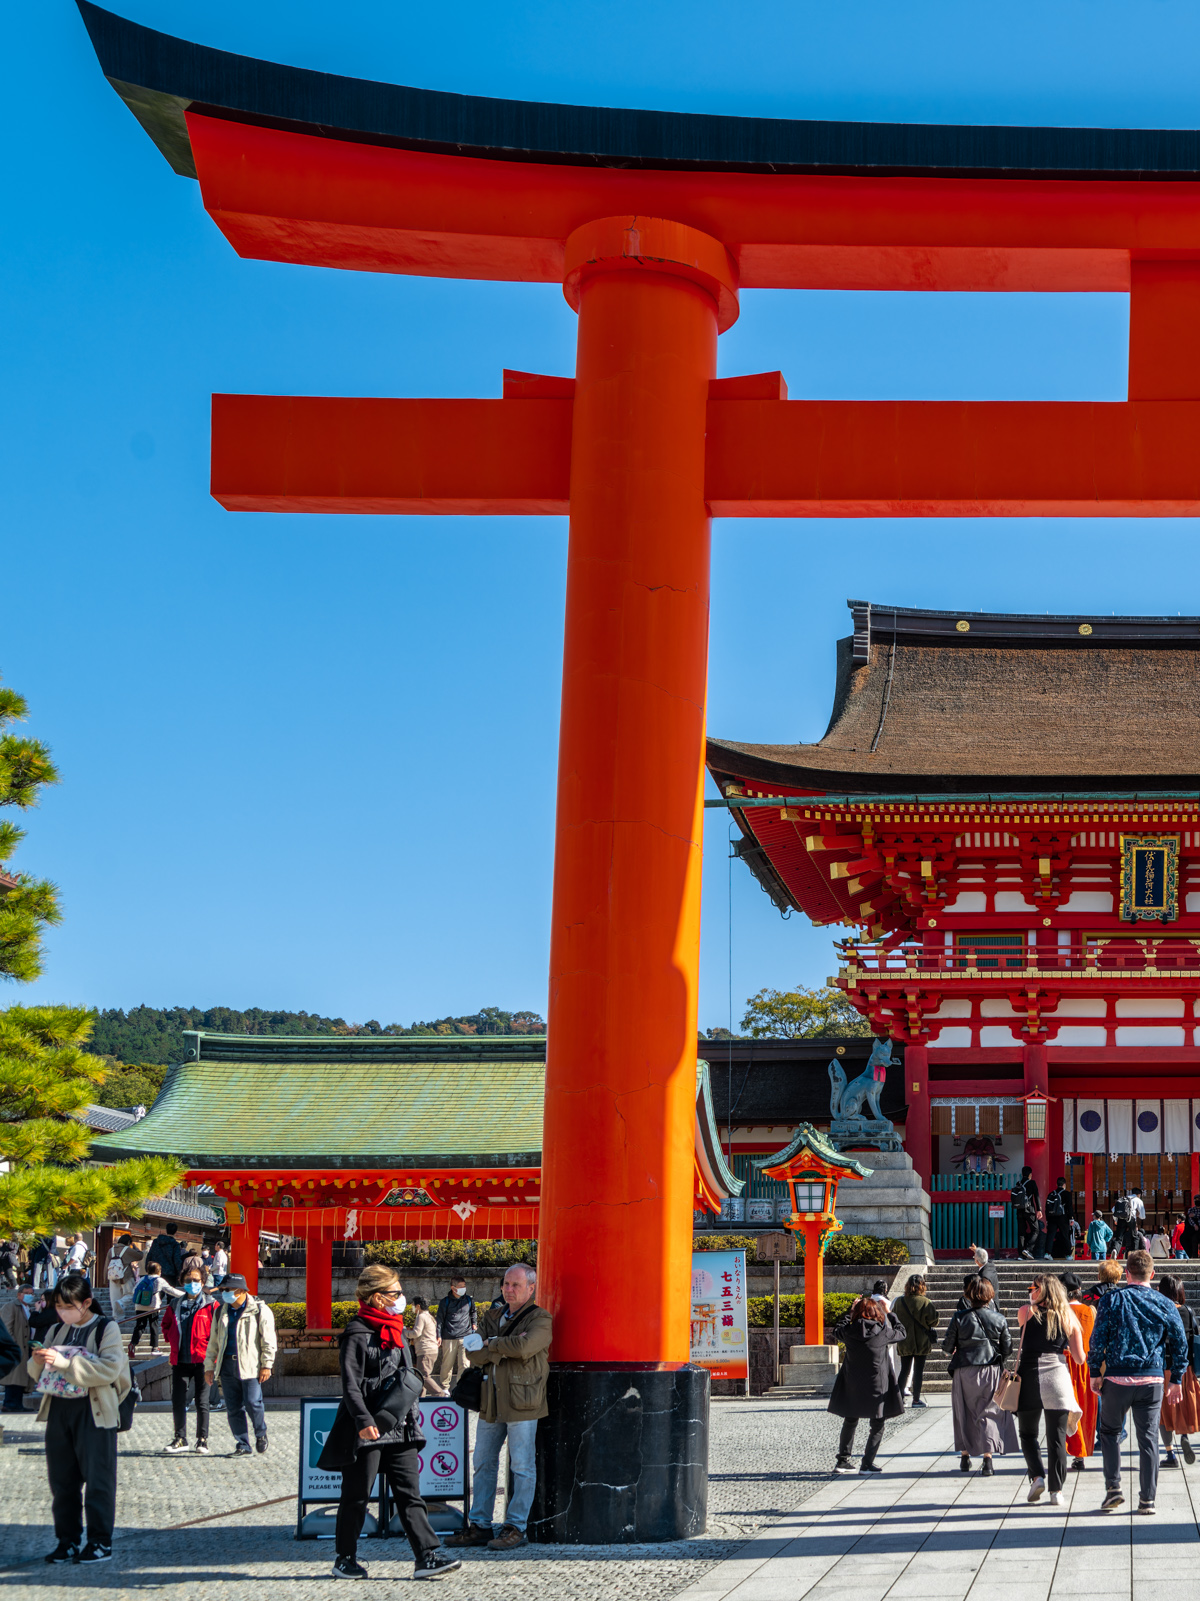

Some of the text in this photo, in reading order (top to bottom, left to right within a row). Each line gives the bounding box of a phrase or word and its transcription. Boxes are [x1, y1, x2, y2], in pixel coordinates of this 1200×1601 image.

[720, 1271, 734, 1327] 七五三詣
[734, 1256, 743, 1304] おいなりさんの
